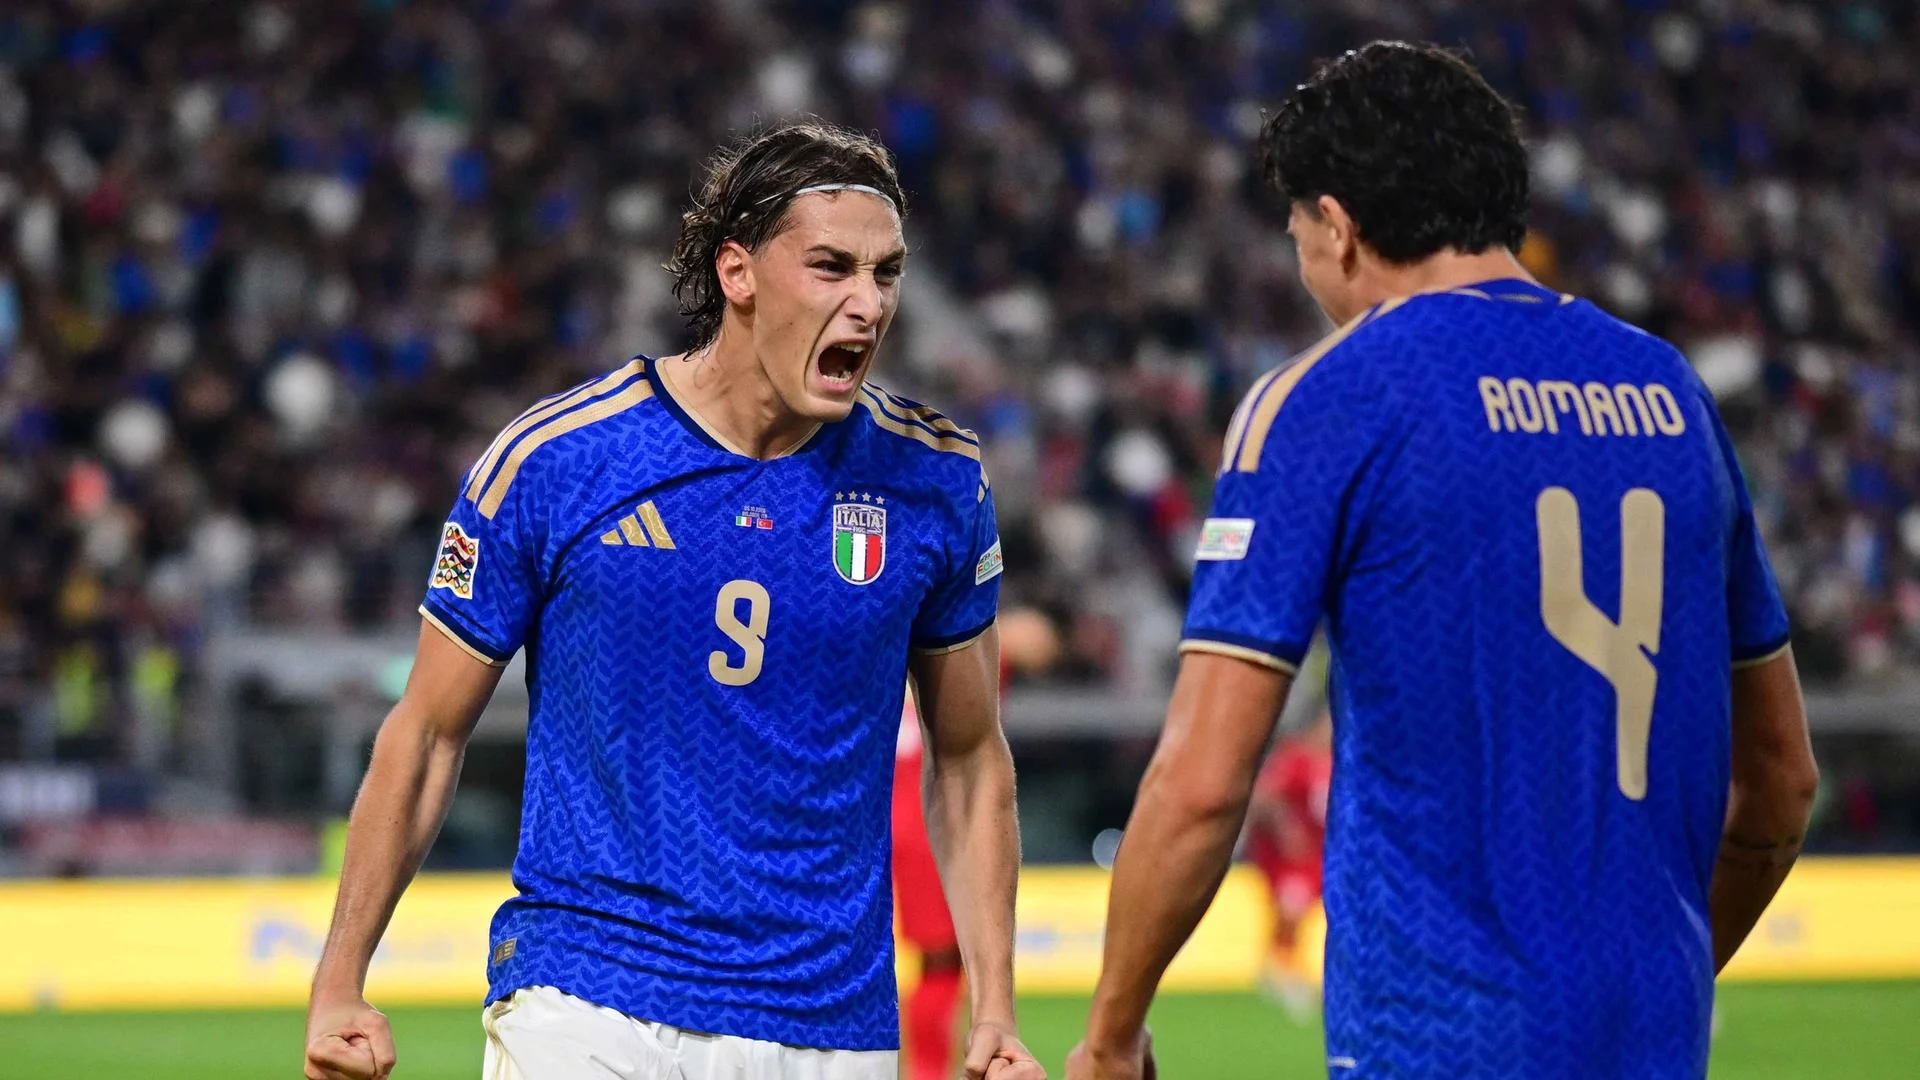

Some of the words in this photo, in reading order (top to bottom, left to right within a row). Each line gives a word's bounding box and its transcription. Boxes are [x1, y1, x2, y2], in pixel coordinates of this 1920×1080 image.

[1478, 376, 1686, 437] ROMANO
[837, 509, 881, 528] ITALIA
[708, 580, 770, 687] 9
[1535, 486, 1665, 801] 4
